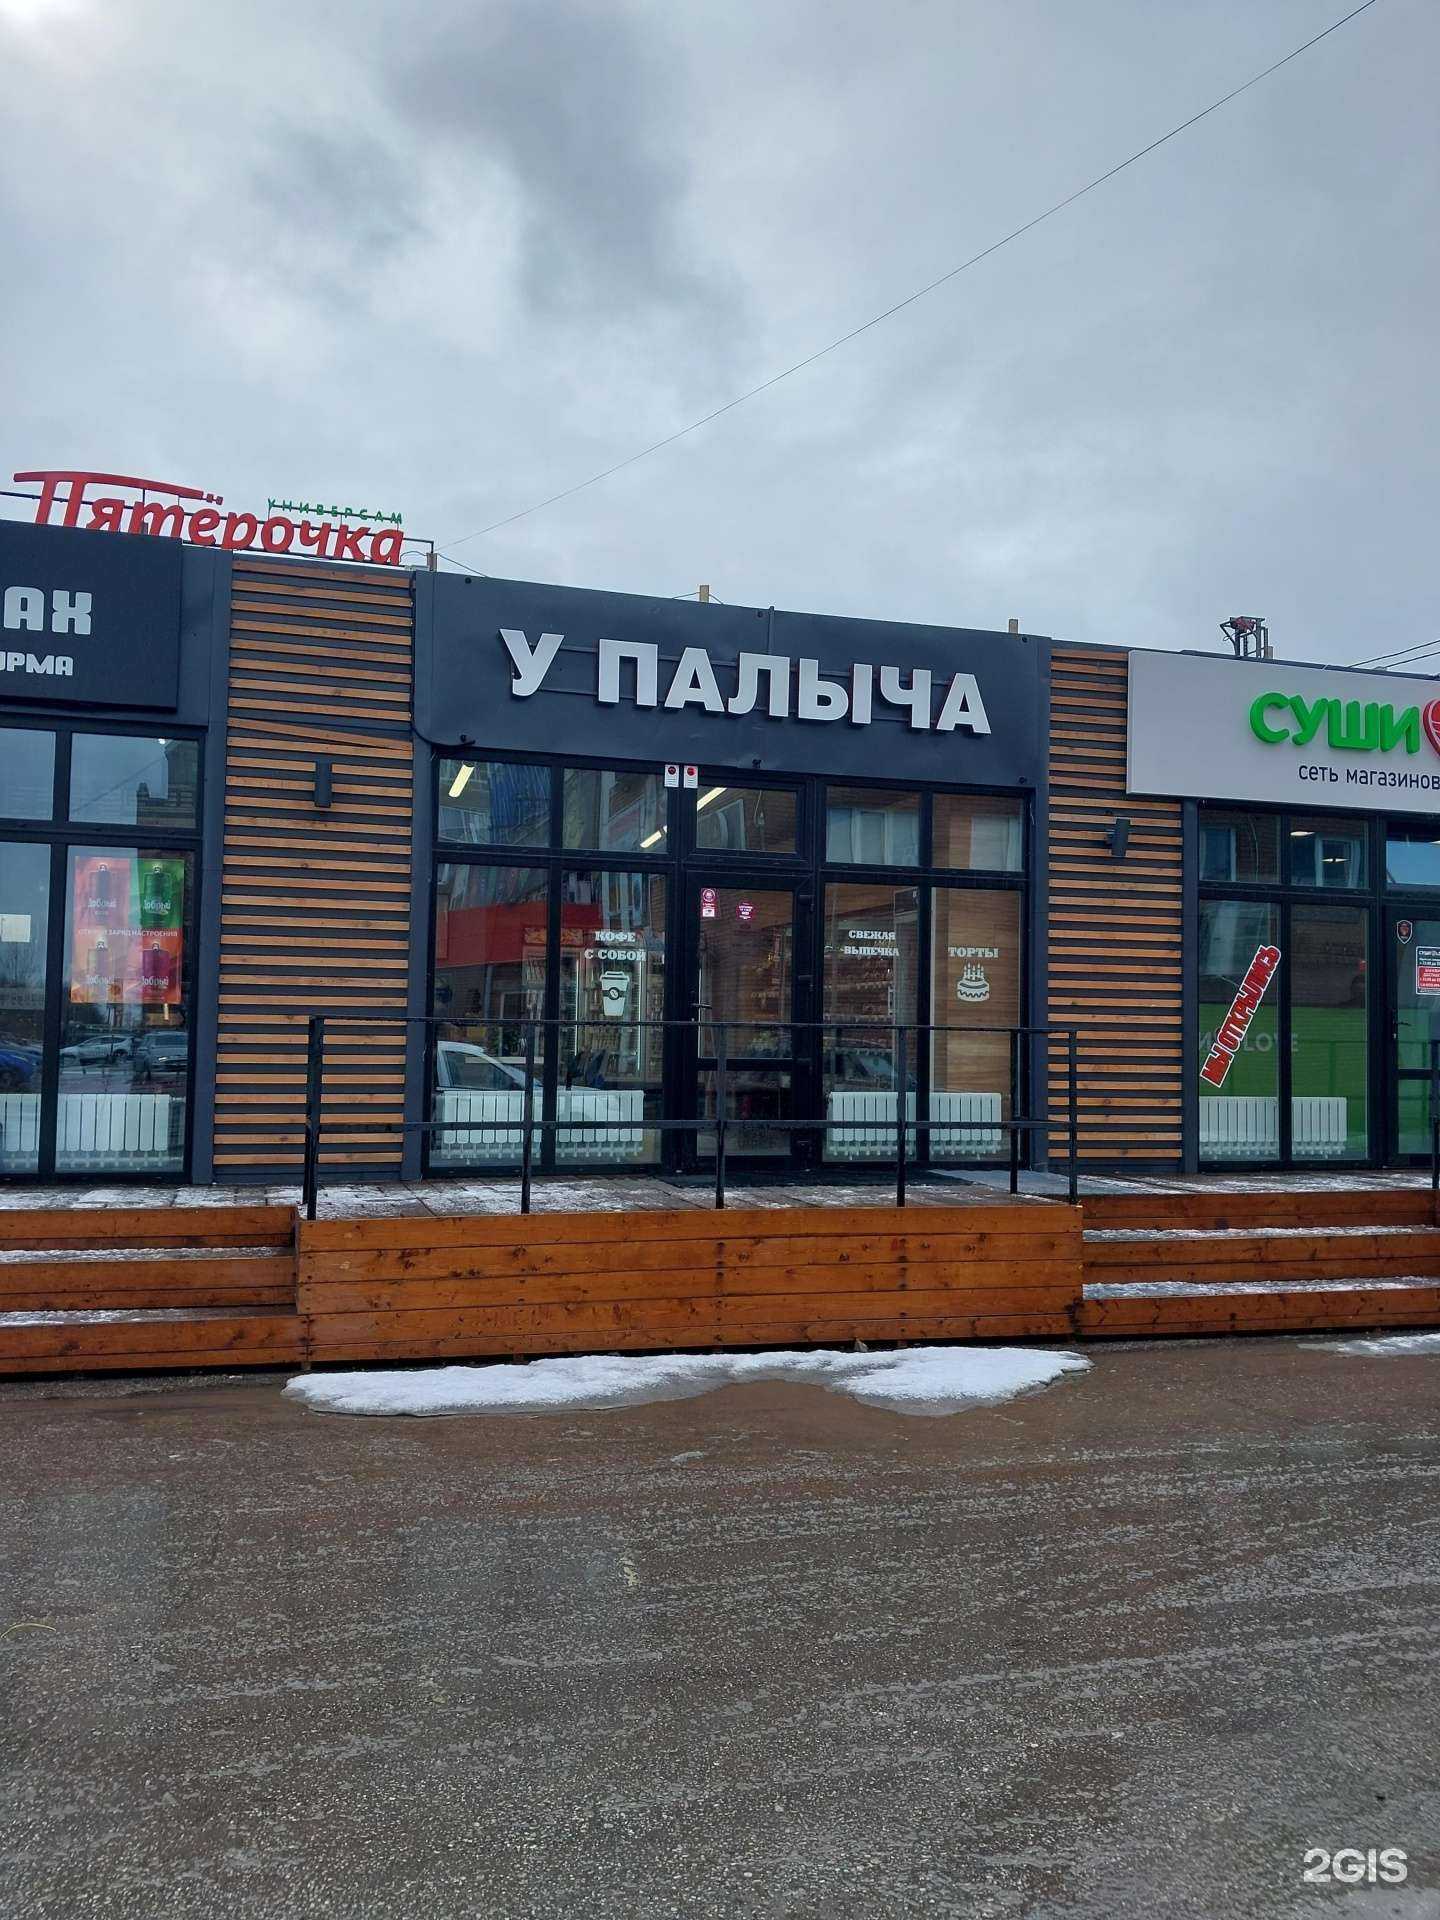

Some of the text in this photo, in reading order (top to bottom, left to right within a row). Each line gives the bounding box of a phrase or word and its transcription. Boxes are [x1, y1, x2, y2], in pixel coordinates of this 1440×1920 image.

[13, 470, 404, 565] Пятёрочка
[267, 498, 403, 525] УНИВЕРСАМ
[3, 586, 92, 635] АХ
[498, 628, 992, 735] У ПАЛЫЧА
[1249, 691, 1421, 754] СУШИ
[1298, 764, 1440, 790] сеть магазинов
[594, 930, 636, 943] КОФЕ
[848, 929, 896, 940] СВЕЖАЯ
[584, 948, 647, 962] С СОБОЙ
[843, 945, 900, 957] ВЫПЕЧКА
[948, 947, 1000, 958] ТОРТЫ
